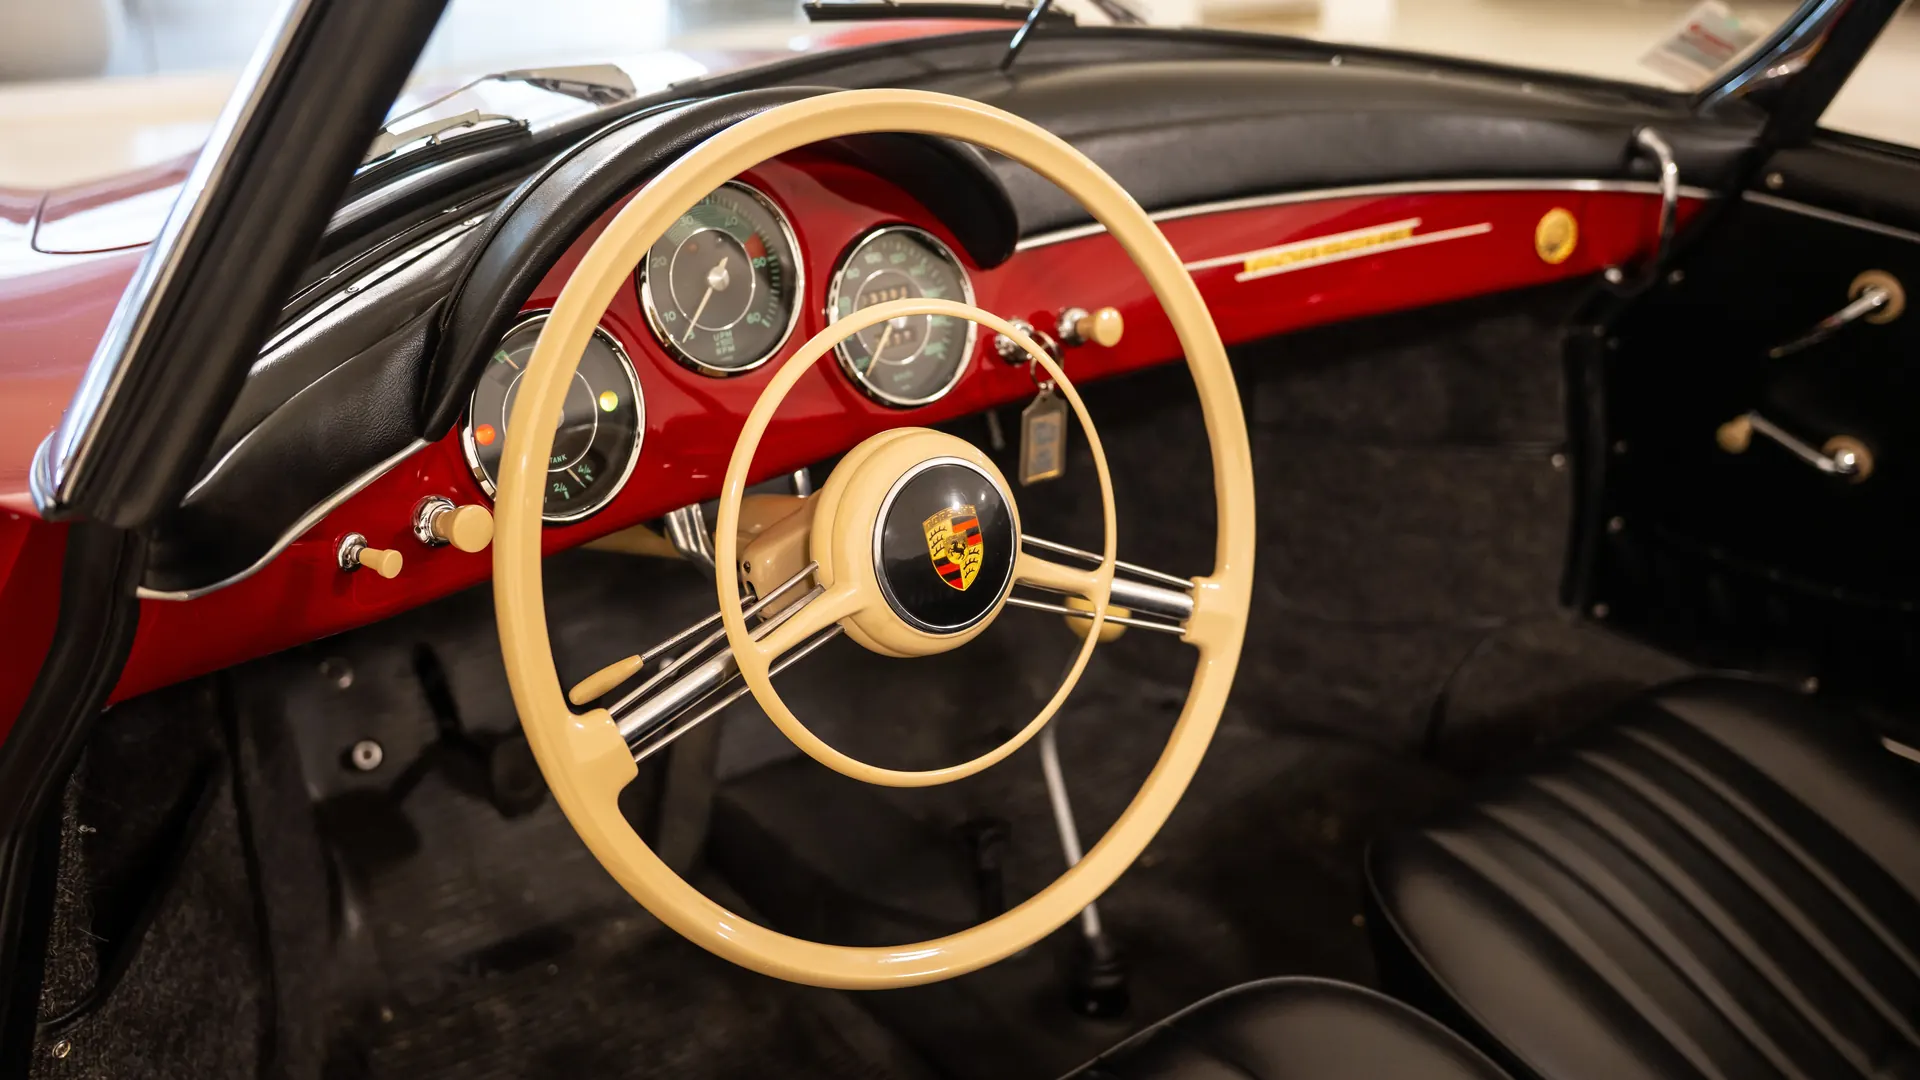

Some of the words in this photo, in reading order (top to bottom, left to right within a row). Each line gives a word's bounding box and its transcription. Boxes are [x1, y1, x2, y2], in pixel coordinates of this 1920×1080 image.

[651, 256, 667, 268] 20
[663, 311, 676, 323] 10
[746, 312, 761, 325] 60
[550, 453, 568, 464] TANK
